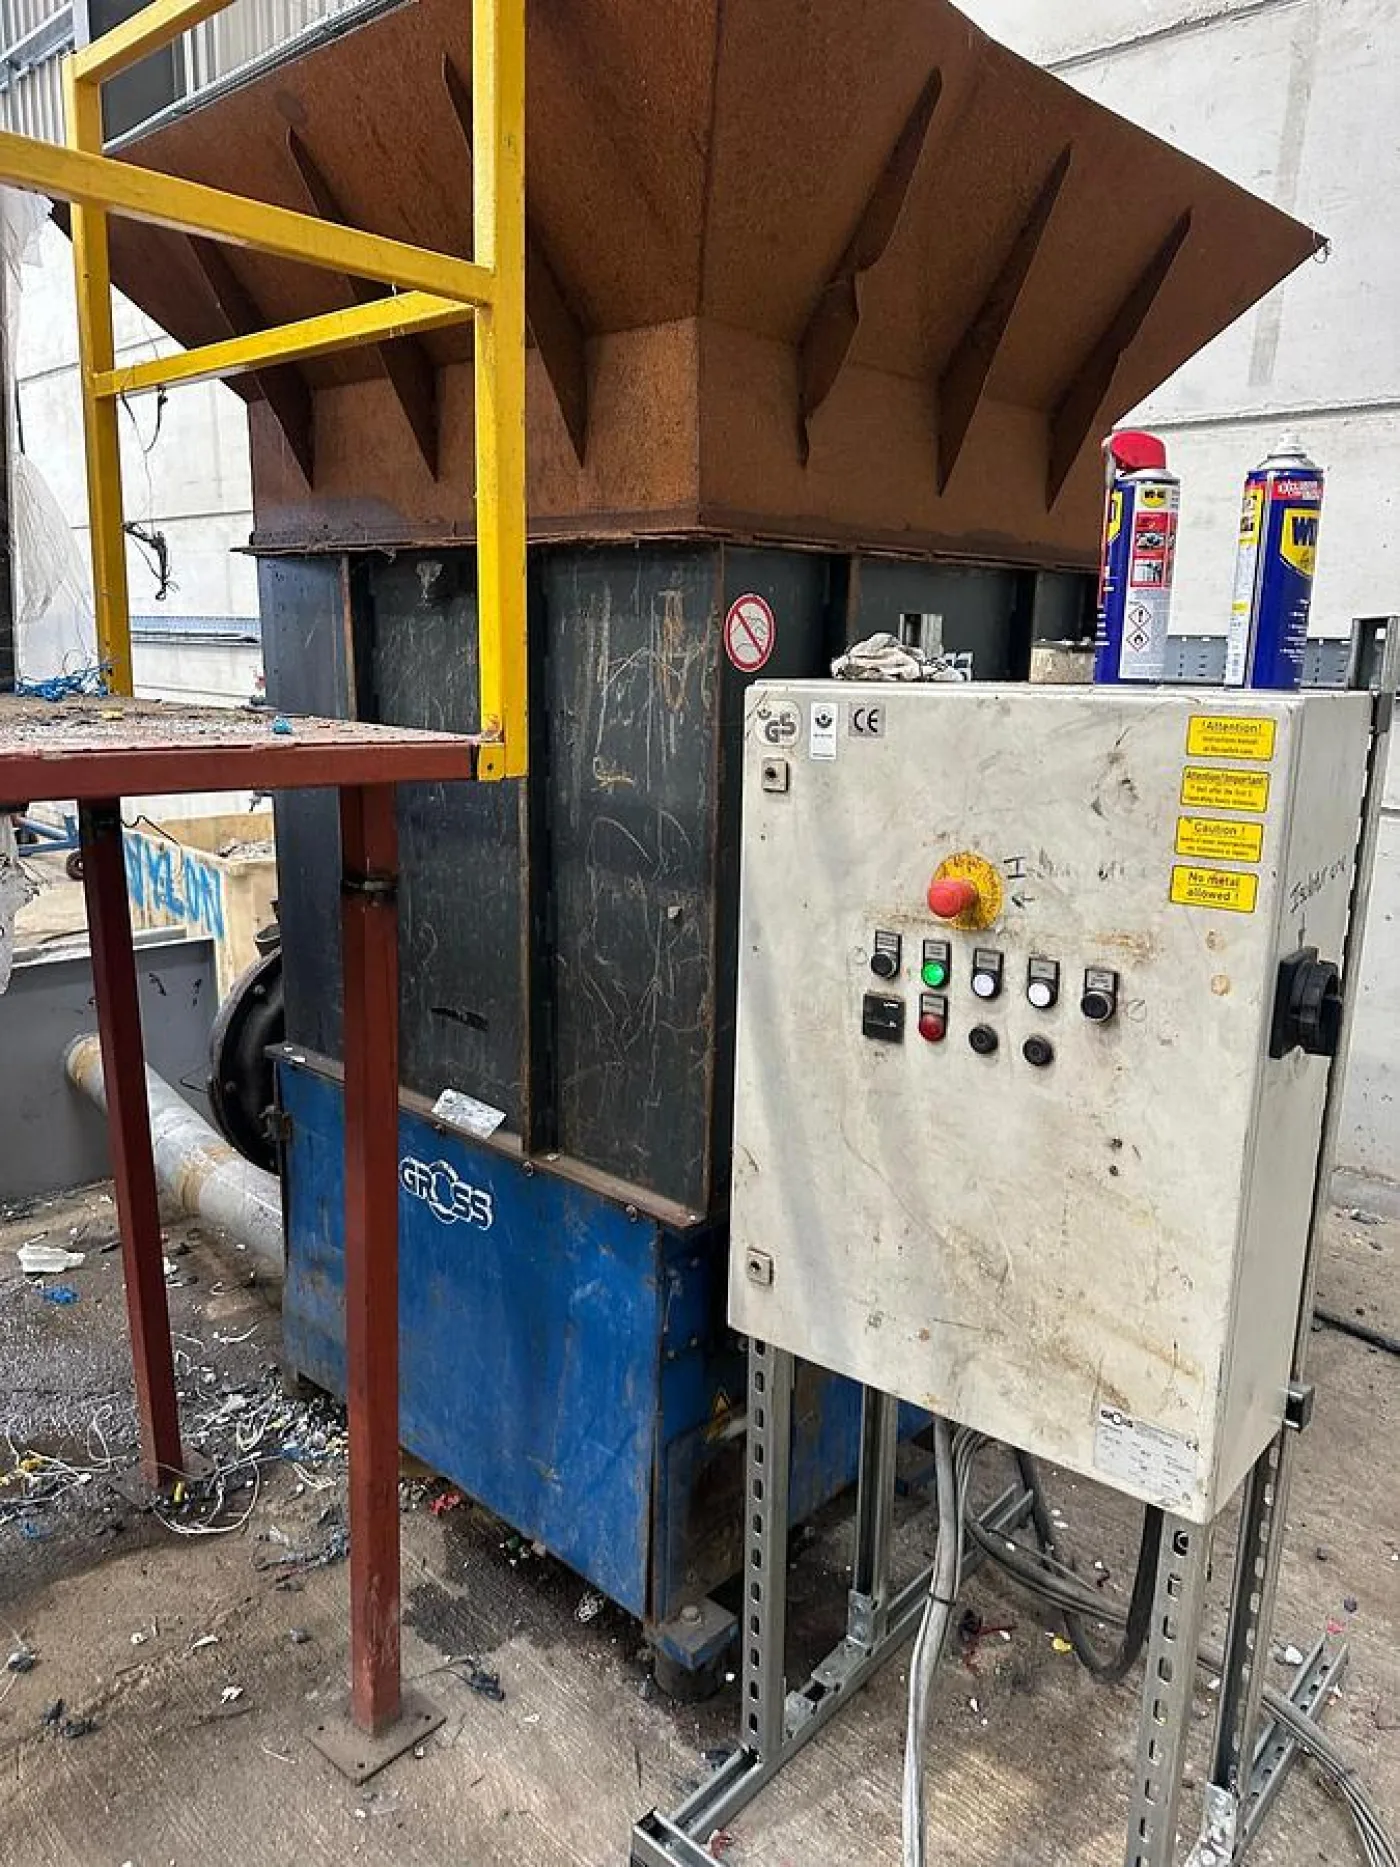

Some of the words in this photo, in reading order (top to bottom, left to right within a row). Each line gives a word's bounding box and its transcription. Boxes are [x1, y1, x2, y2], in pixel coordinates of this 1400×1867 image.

[854, 708, 880, 733] CE
[1194, 822, 1237, 836] Caution
[123, 833, 225, 941] NYLON
[1188, 872, 1204, 884] No
[1207, 875, 1239, 888] metal
[1186, 887, 1231, 902] allowed
[400, 1155, 494, 1231] GROSS
